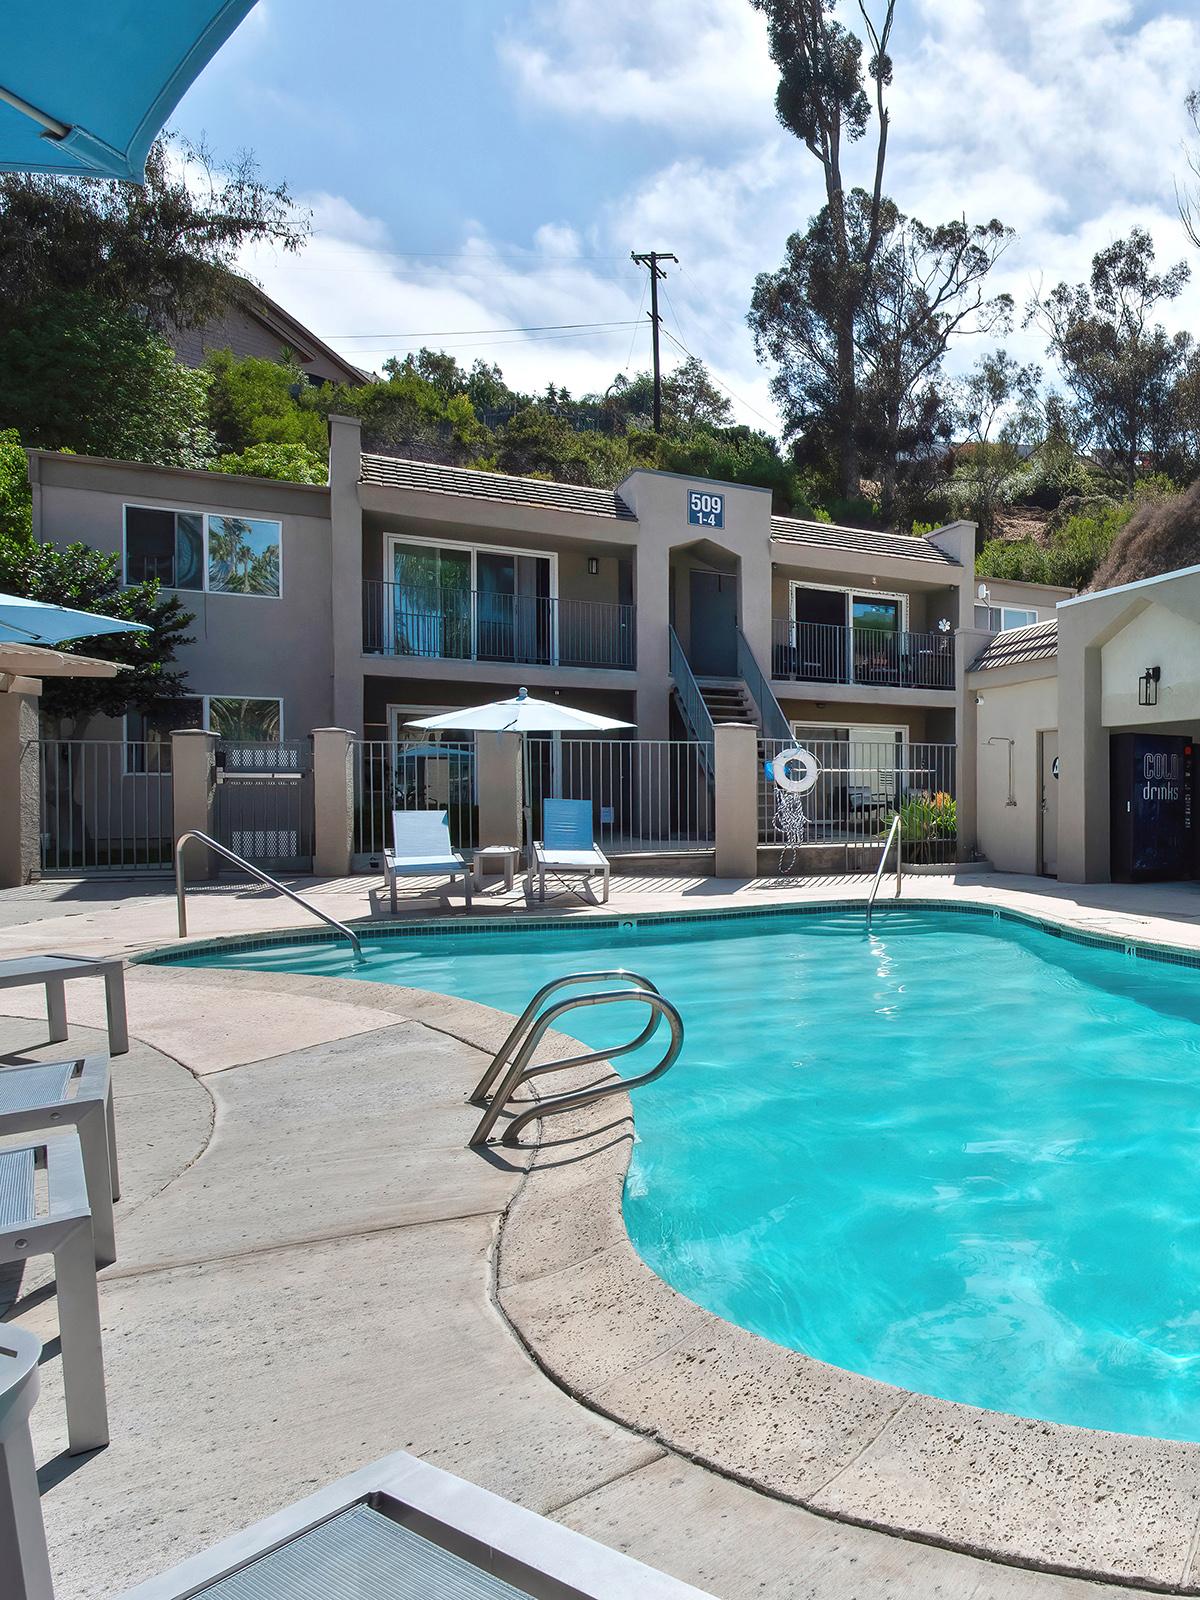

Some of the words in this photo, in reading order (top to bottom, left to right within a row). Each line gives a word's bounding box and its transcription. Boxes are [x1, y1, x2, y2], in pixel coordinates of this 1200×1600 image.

[691, 494, 721, 513] 509
[697, 512, 716, 526] 1-4
[1143, 781, 1179, 800] drinks
